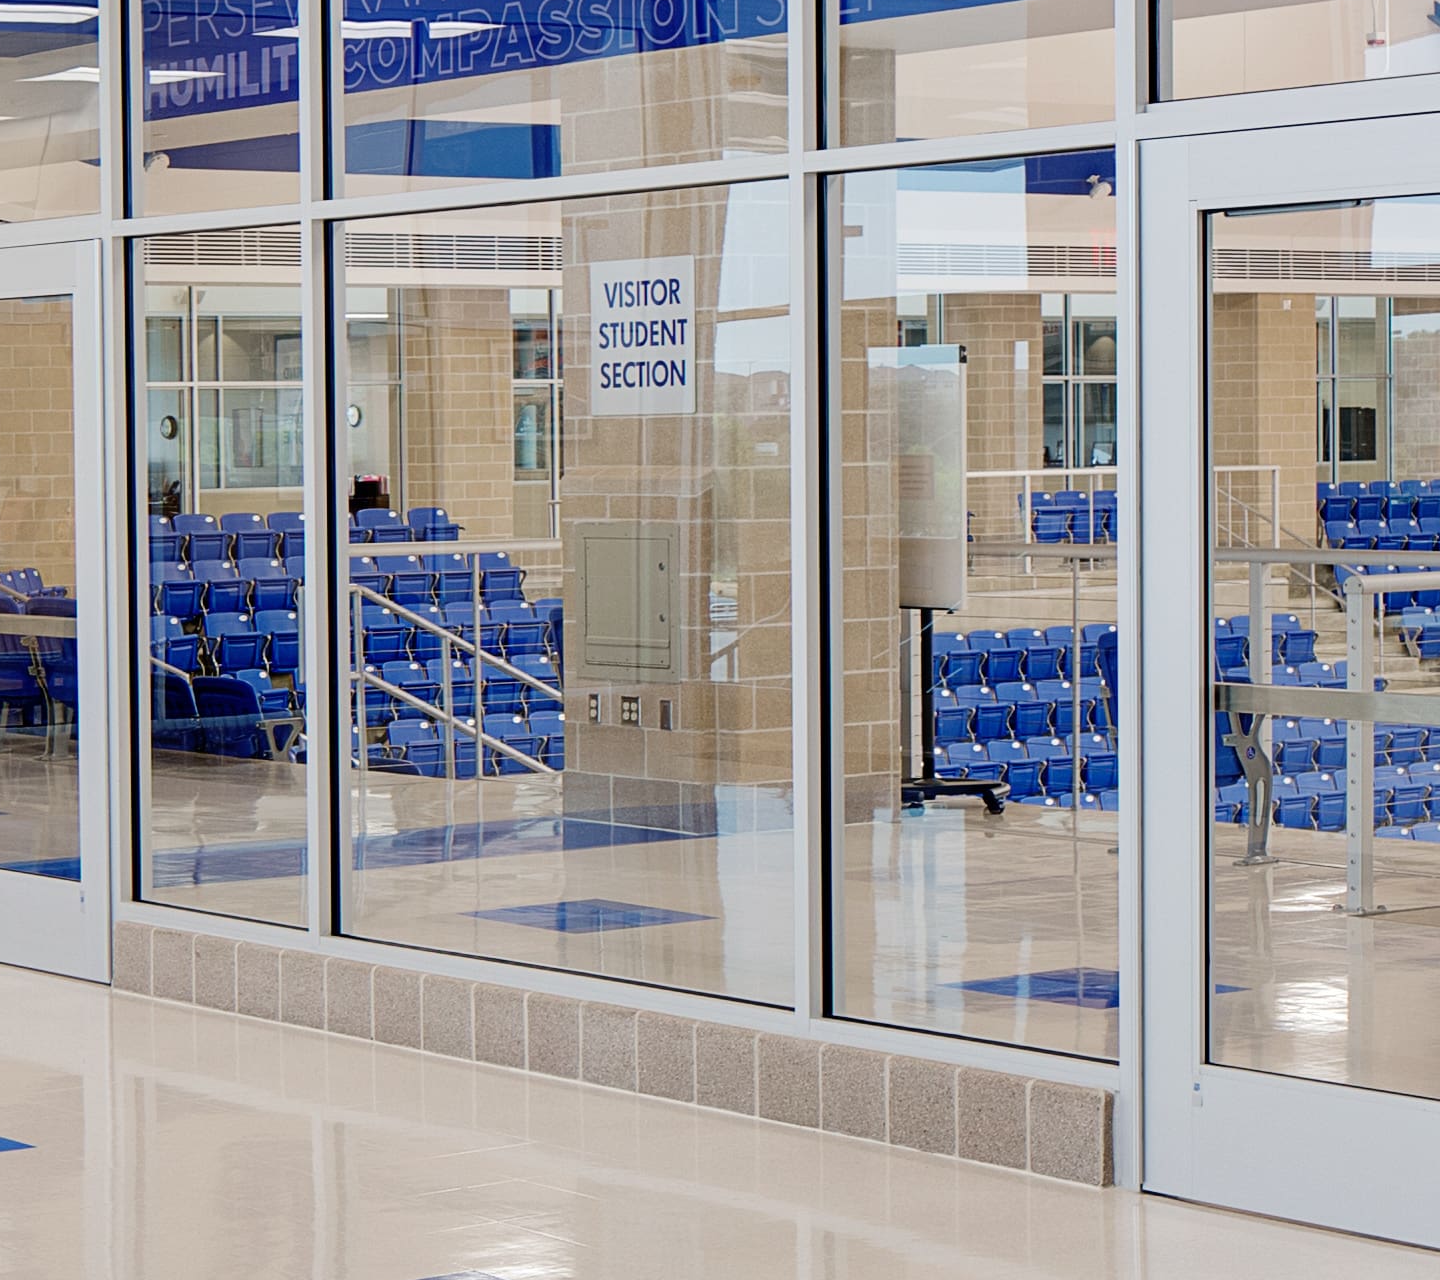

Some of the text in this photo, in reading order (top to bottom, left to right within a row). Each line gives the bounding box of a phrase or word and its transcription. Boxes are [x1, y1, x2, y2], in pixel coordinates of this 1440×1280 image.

[144, 43, 297, 112] HUMILIT
[604, 278, 681, 308] VISITOR
[599, 319, 688, 349] STUDENT
[600, 359, 687, 389] SECTION
